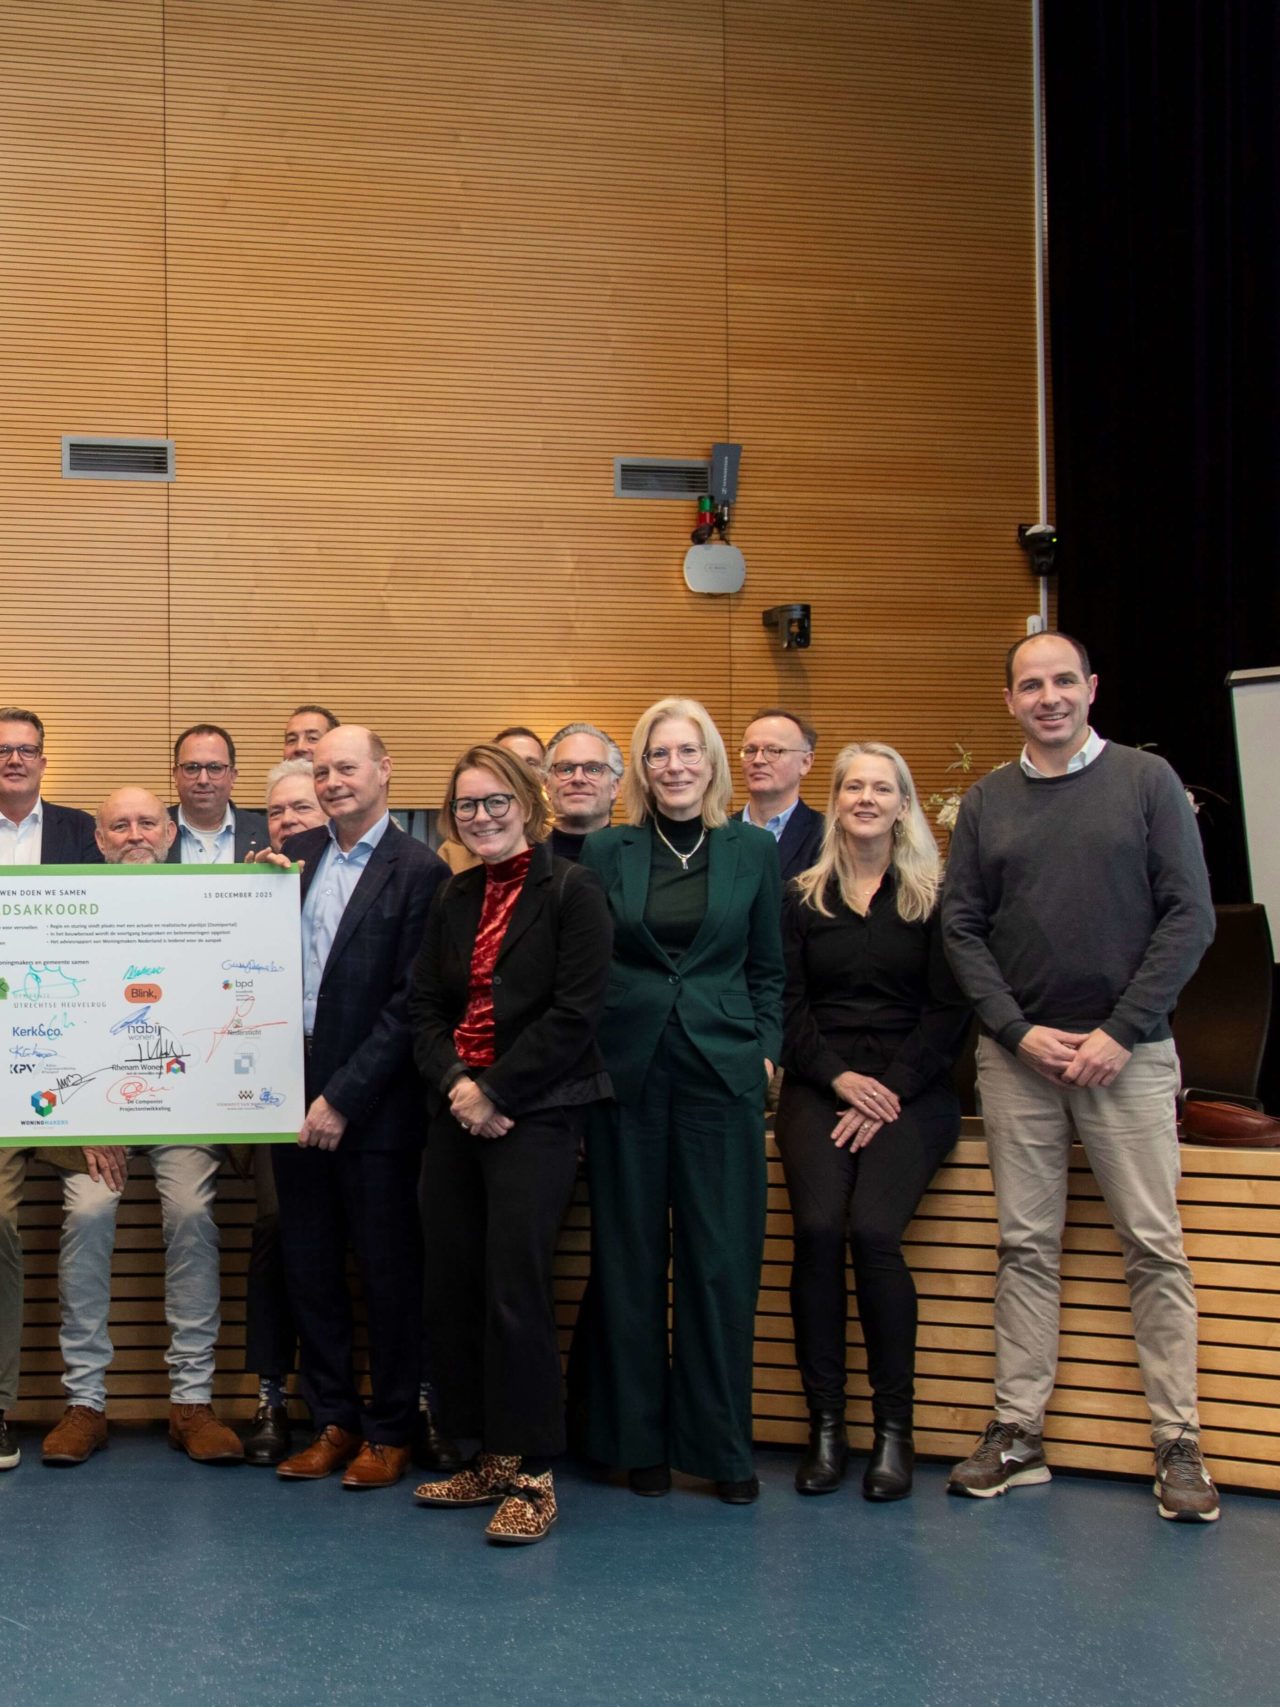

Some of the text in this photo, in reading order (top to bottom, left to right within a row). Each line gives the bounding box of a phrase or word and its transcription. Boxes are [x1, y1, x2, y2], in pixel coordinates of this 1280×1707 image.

[235, 979, 254, 989] bpd
[12, 1023, 63, 1037] Kerk&co.
[10, 1063, 36, 1074] KPV
[112, 1063, 140, 1071] Rhenam
